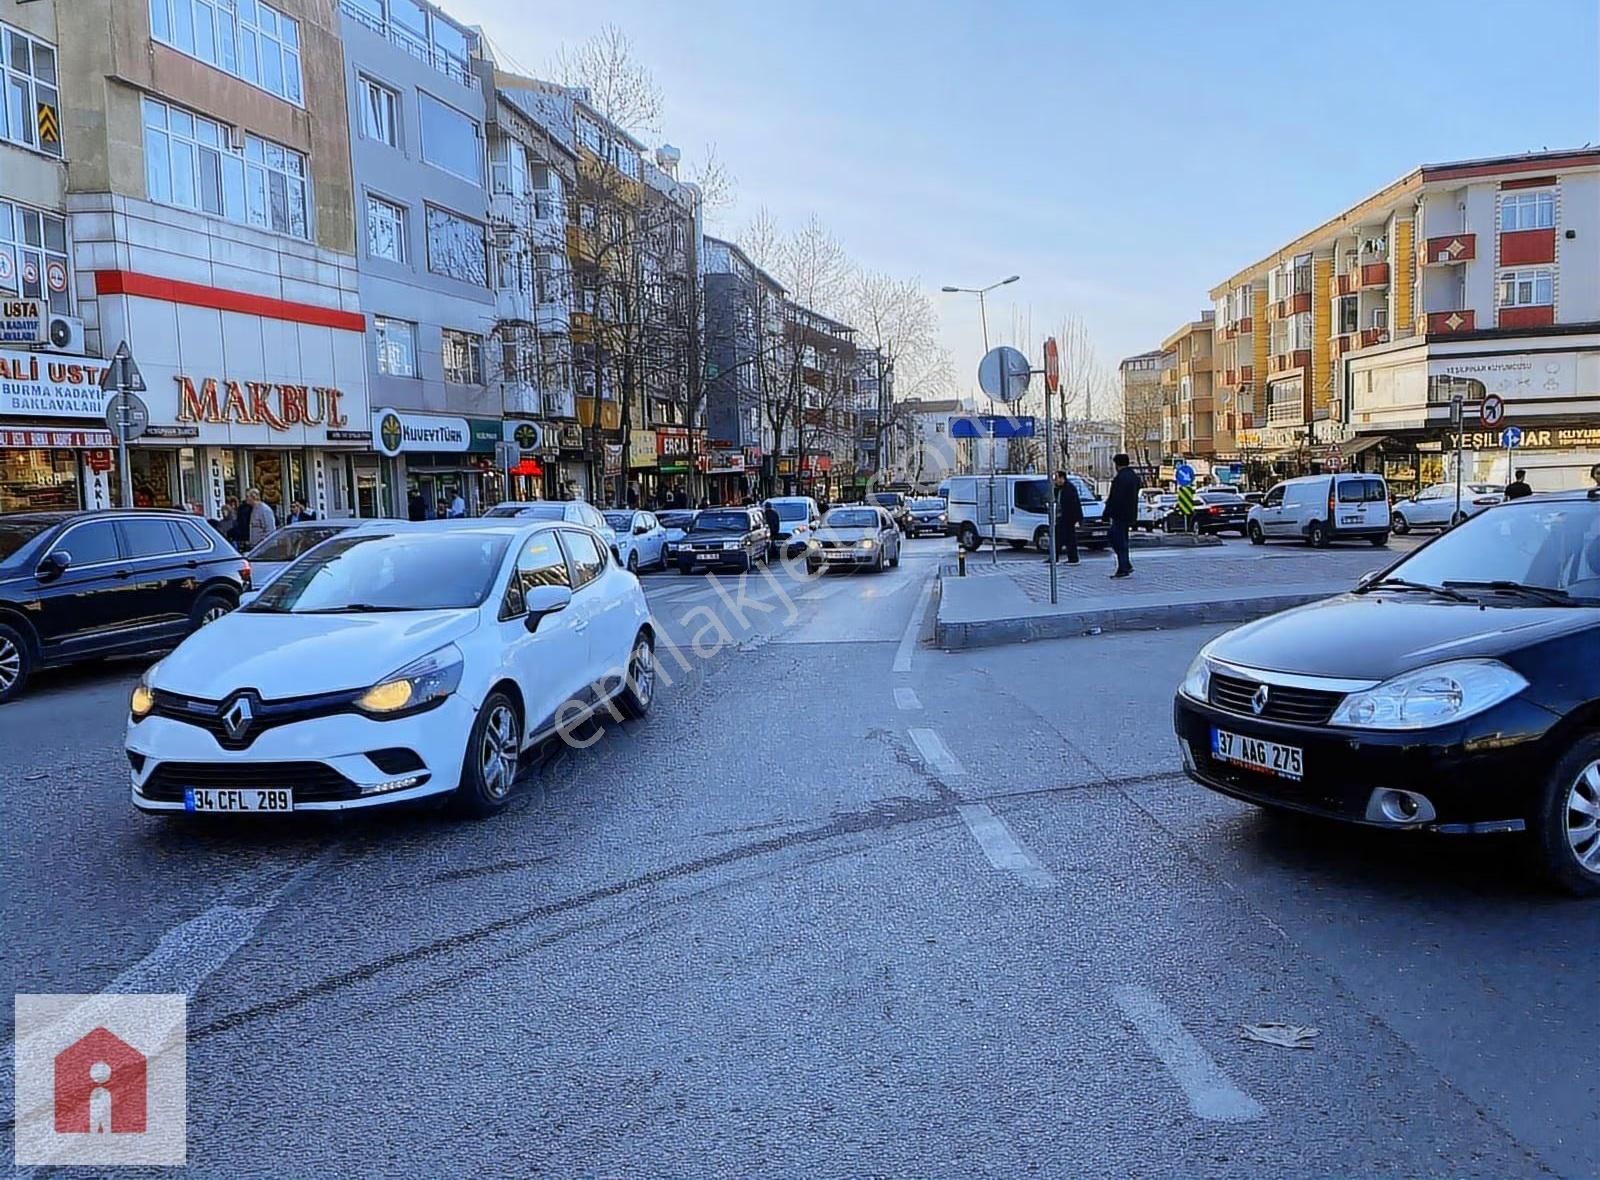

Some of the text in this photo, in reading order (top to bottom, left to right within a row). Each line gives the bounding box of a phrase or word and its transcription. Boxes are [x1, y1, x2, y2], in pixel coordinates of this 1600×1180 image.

[3, 302, 38, 317] USTA
[3, 384, 107, 400] BURMA KADAYIF
[12, 398, 101, 412] BAKLAVALARI
[174, 375, 344, 431] MAKBUL
[1220, 732, 1234, 755] 37
[1272, 745, 1301, 772] 275
[194, 791, 288, 810] 34 CFL 289
